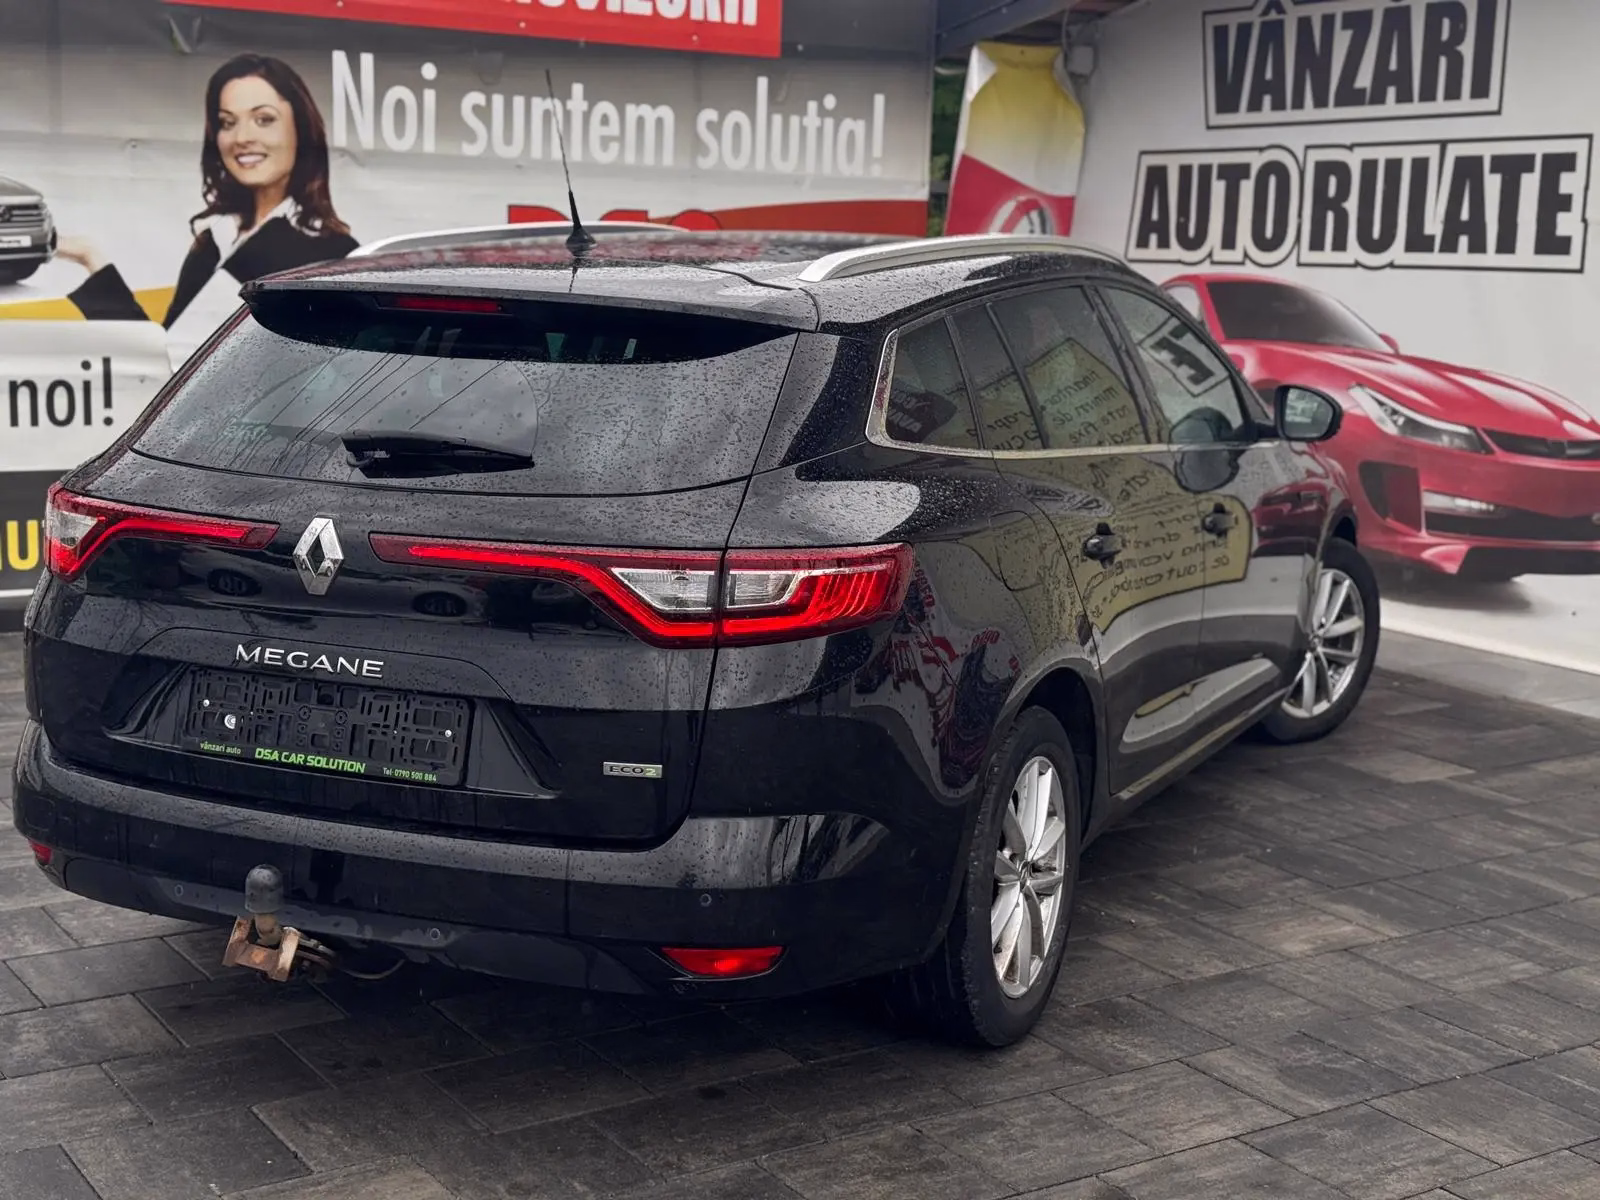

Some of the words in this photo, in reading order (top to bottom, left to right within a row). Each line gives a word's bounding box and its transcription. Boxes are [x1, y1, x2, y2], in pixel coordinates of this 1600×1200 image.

[331, 50, 437, 153] Noi
[460, 82, 674, 167] suntem
[1136, 160, 1291, 252] AUTO
[1309, 152, 1577, 256] RULATE
[8, 356, 114, 428] noi!
[235, 643, 385, 679] MEGANE
[254, 747, 279, 761] DSA
[281, 751, 305, 766] CAR
[306, 755, 366, 774] SOLUTION
[609, 765, 657, 777] ECO2
